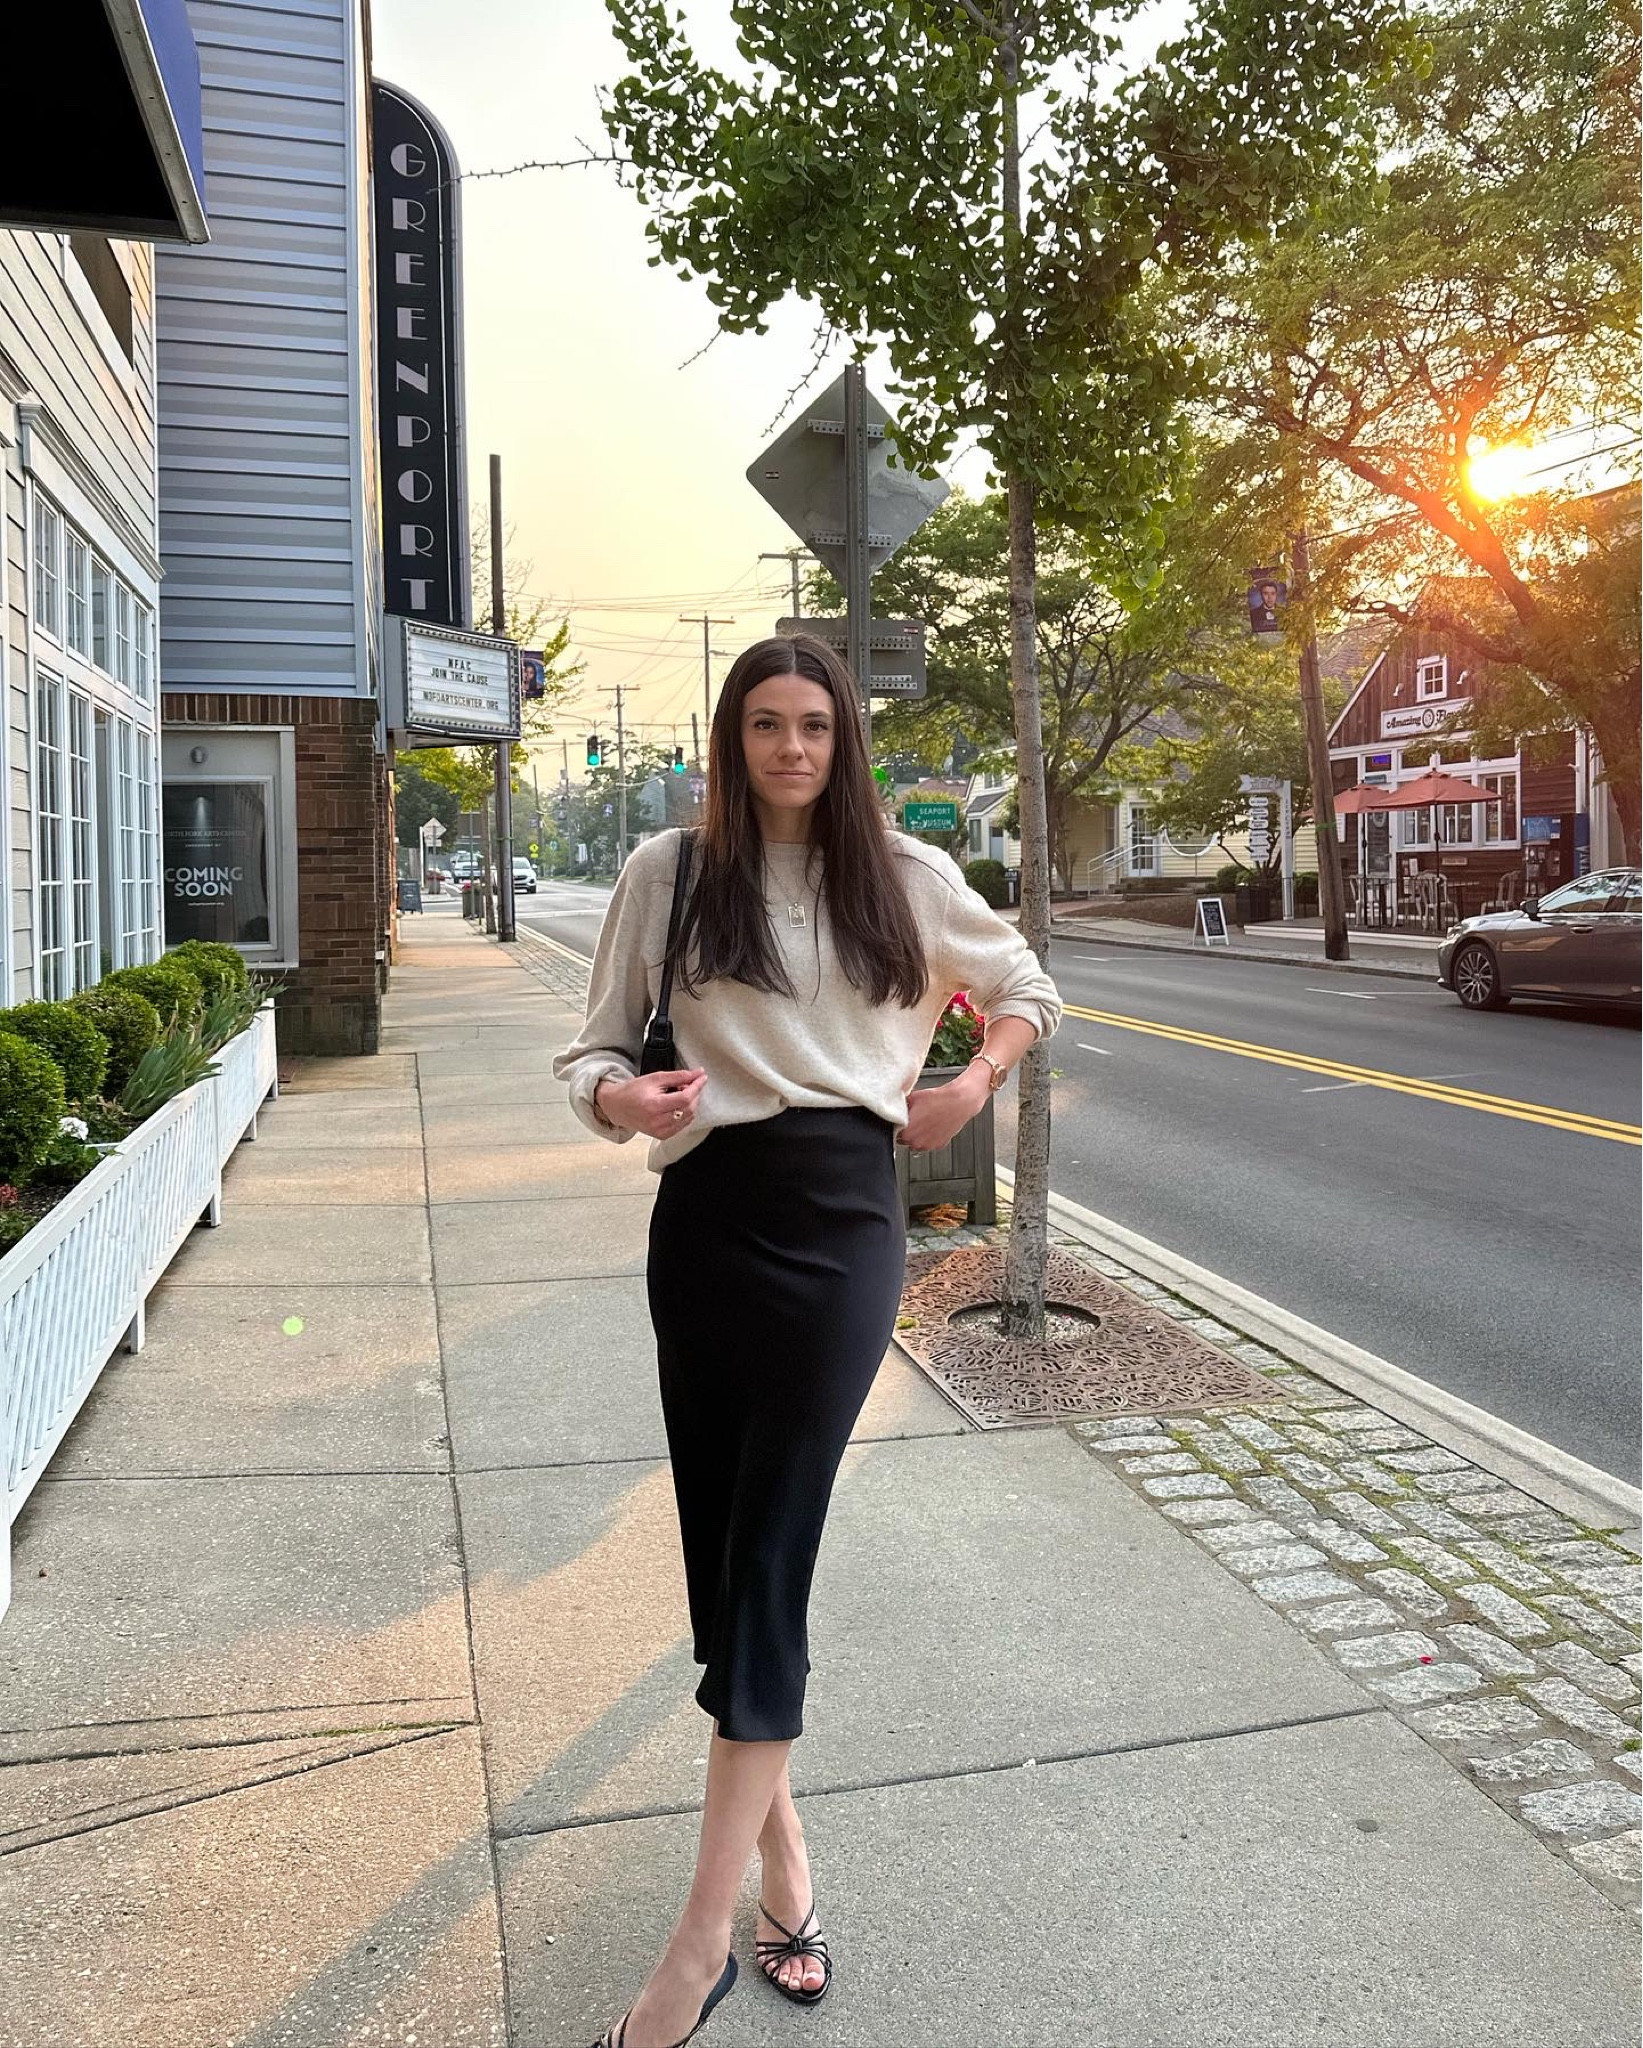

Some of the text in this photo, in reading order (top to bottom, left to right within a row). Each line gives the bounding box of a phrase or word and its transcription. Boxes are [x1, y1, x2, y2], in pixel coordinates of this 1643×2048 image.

[390, 143, 434, 611] GREENPORT
[431, 667, 488, 686] JOIN THE CAUSE
[919, 807, 951, 815] SEAPORT
[165, 866, 244, 882] COMING
[174, 881, 233, 897] SOON
